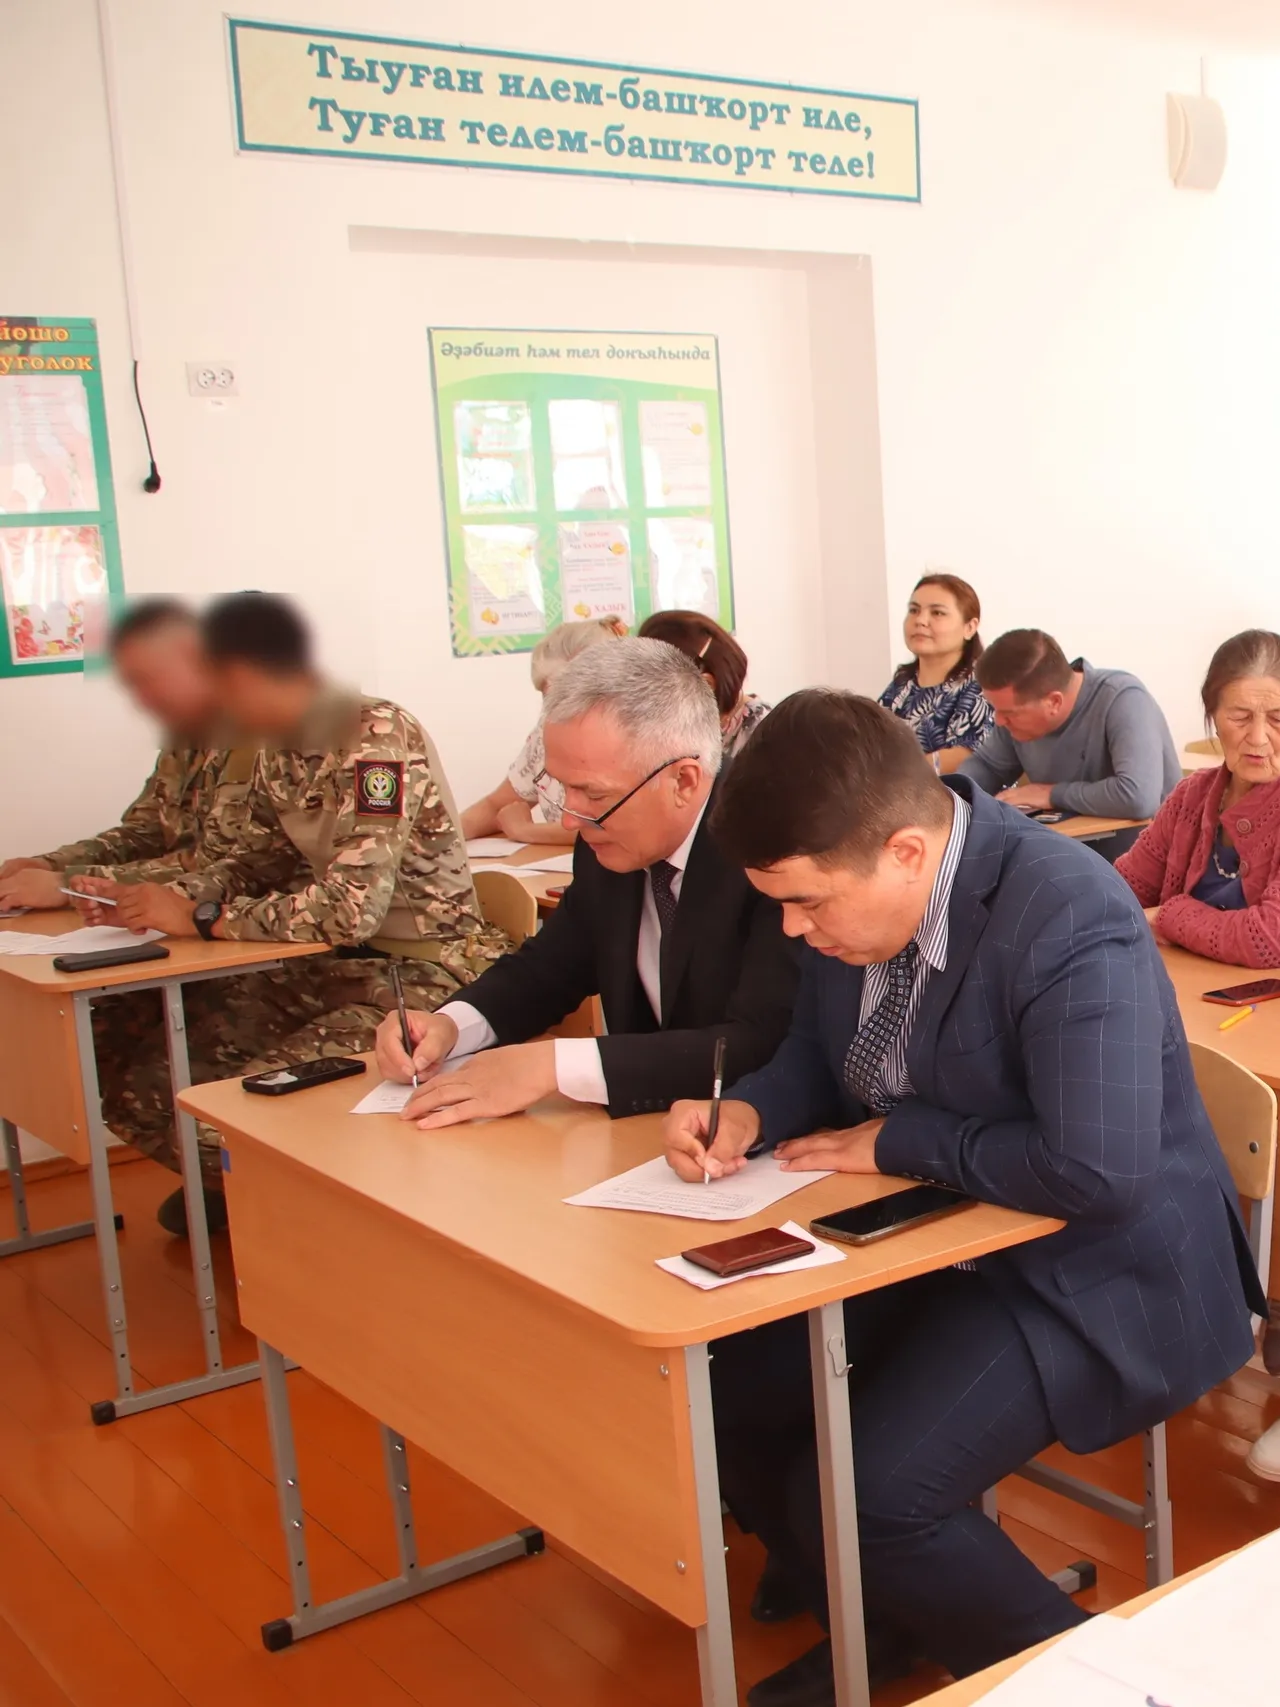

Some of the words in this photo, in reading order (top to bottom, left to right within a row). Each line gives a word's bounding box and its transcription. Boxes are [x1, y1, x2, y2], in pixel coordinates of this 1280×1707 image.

[306, 42, 484, 95] Тыуған
[498, 73, 791, 131] илем-башҡорт
[802, 106, 872, 140] иле,
[308, 96, 446, 144] Туған
[459, 118, 776, 176] телем-башҡорт
[787, 149, 875, 179] теле!
[0, 355, 93, 375] уголок
[527, 344, 561, 358] һәм
[566, 347, 600, 359] тел
[606, 344, 711, 360] донъяһында
